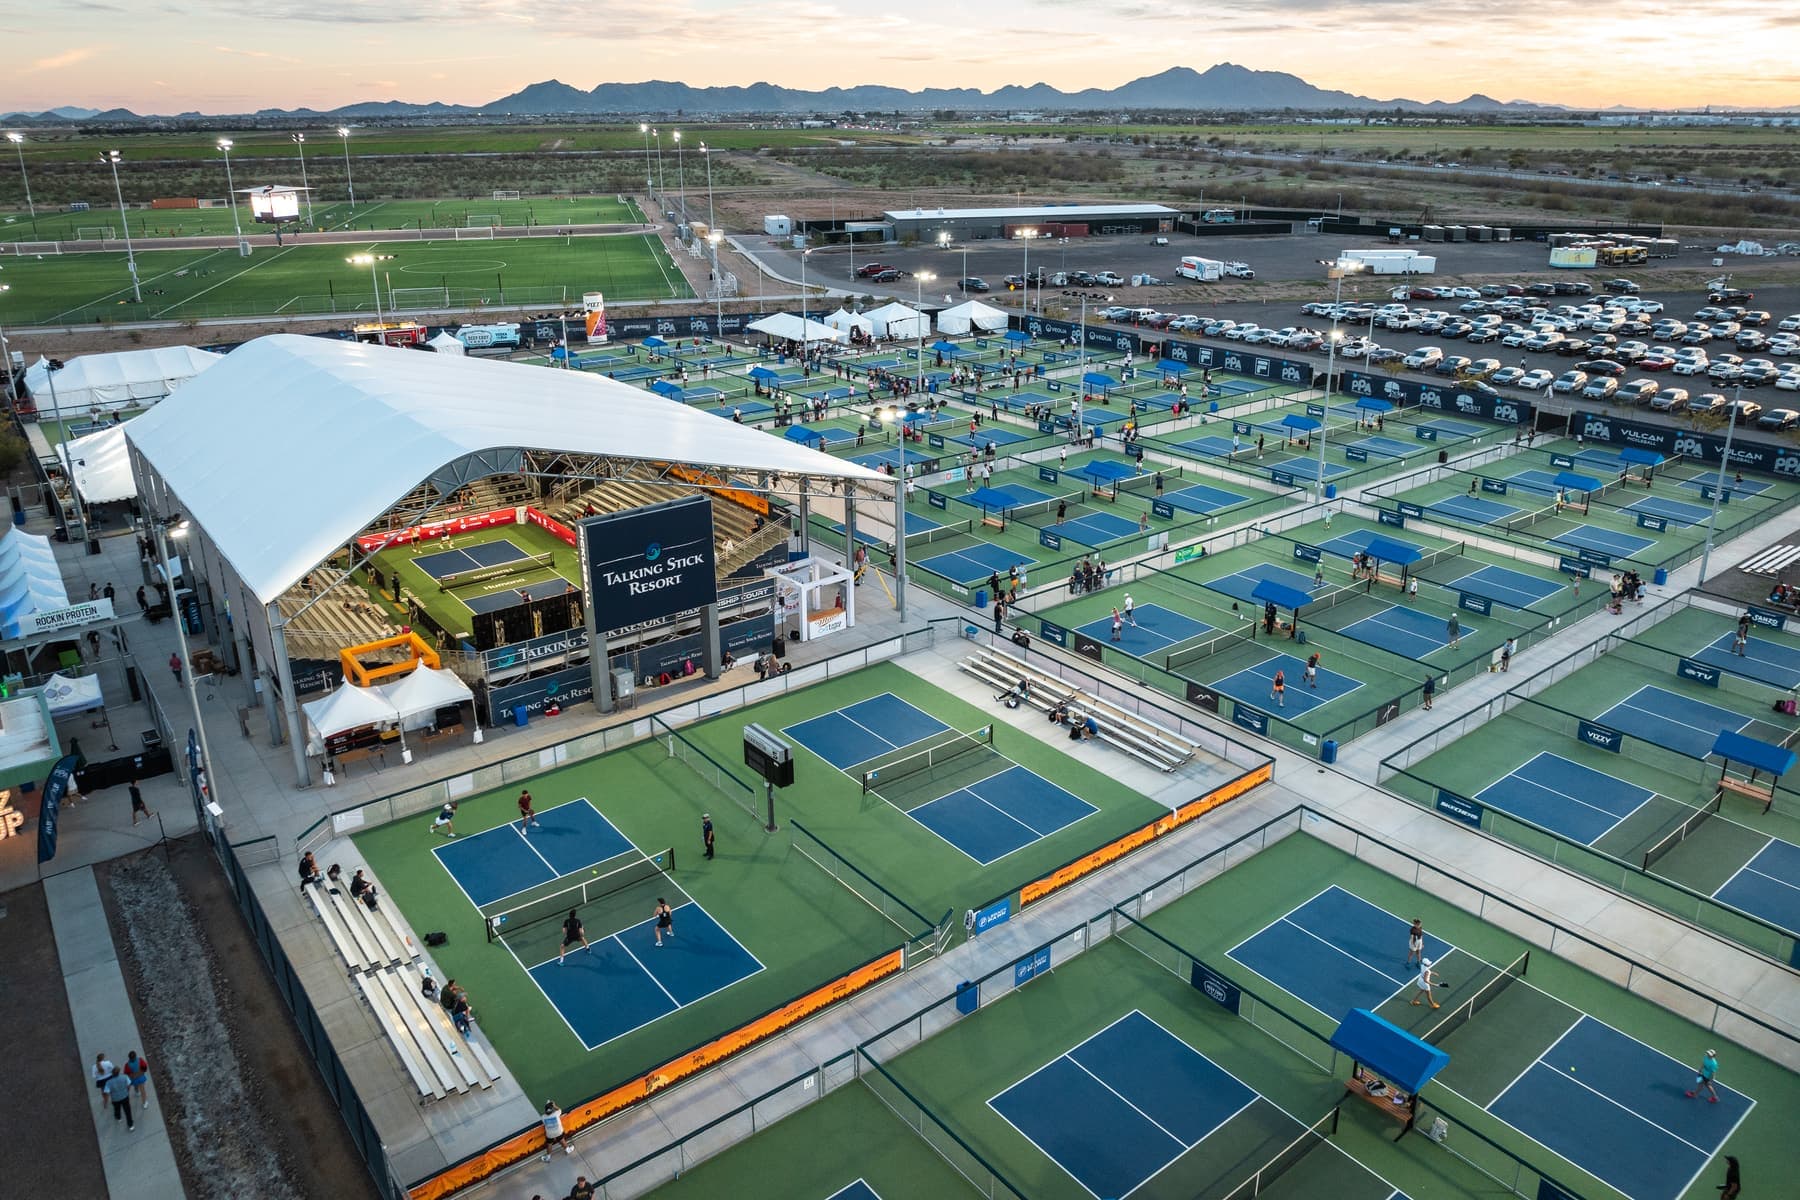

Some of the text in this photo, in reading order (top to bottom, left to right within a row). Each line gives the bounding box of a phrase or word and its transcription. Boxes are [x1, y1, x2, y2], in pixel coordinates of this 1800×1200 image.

[657, 322, 676, 333] PPA
[690, 320, 709, 331] PPA
[1029, 321, 1042, 332] PPA
[1116, 337, 1132, 349] PPA
[1171, 347, 1187, 360] PPA
[1225, 356, 1241, 369] PPA
[1282, 366, 1300, 380] PPA
[1351, 379, 1372, 393] PPA
[1420, 391, 1441, 406] PPA
[1494, 405, 1518, 421] PPA
[1584, 421, 1610, 438] PPA
[1621, 428, 1664, 442] VULCAN
[1674, 438, 1703, 455] PPA
[1721, 454, 1754, 464] PCKLEBALL
[603, 553, 704, 586] TALKING STICK
[629, 573, 682, 596] RESORT
[65, 606, 97, 620] PROTEIN
[1752, 614, 1778, 626] SANZO
[518, 637, 577, 660] TALKING
[741, 588, 768, 600] COURT
[501, 702, 541, 718] TAING
[1587, 731, 1611, 743] VIZZY
